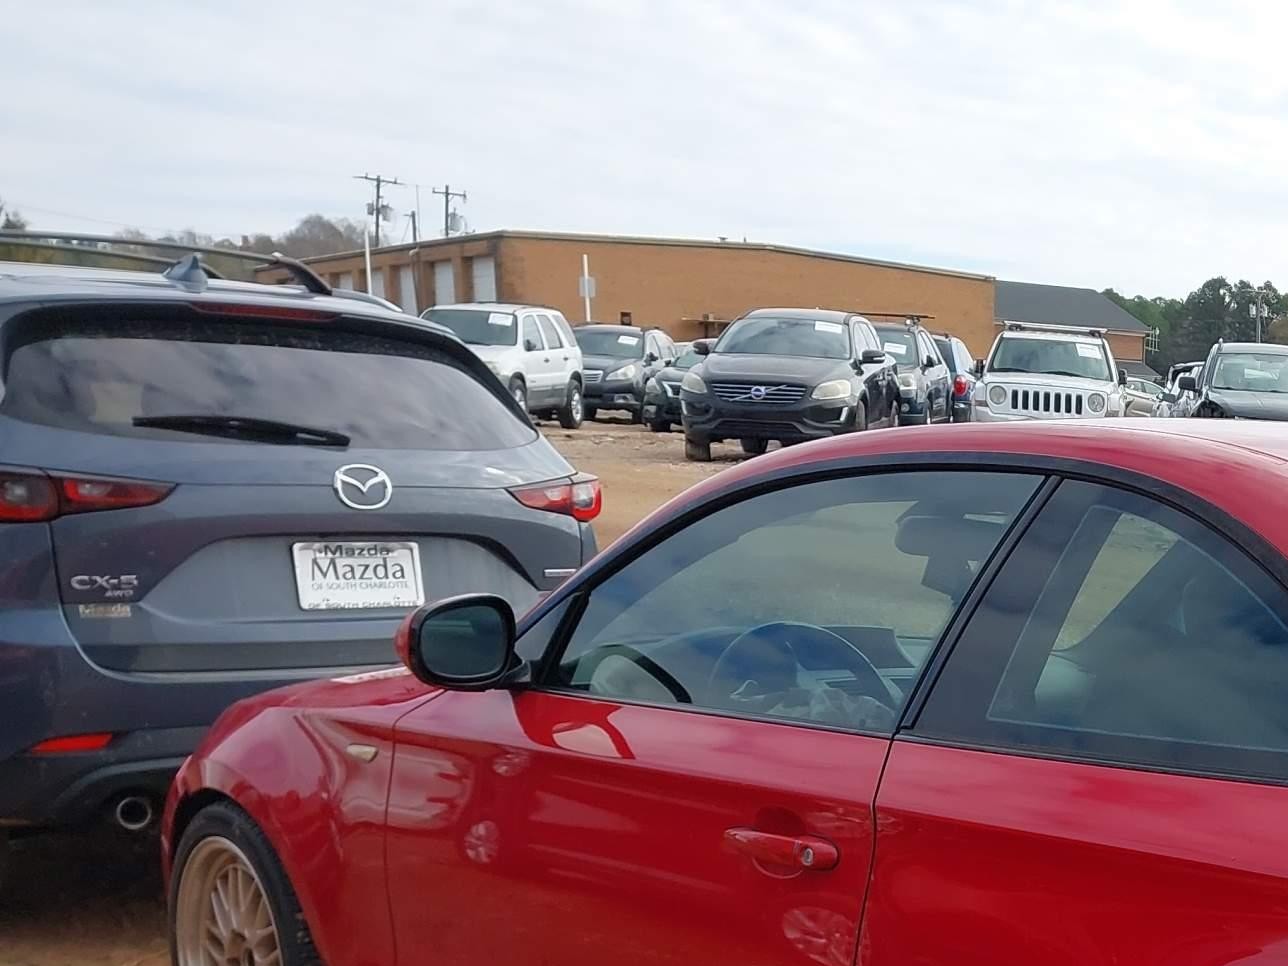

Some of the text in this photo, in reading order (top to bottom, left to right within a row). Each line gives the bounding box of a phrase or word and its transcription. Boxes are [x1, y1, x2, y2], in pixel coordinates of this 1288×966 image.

[324, 545, 391, 556] Mazda
[311, 557, 406, 581] Mazda
[70, 575, 139, 590] CX-5
[311, 581, 409, 591] OF SOUTH CHARLOTTE
[104, 589, 134, 597] AWD
